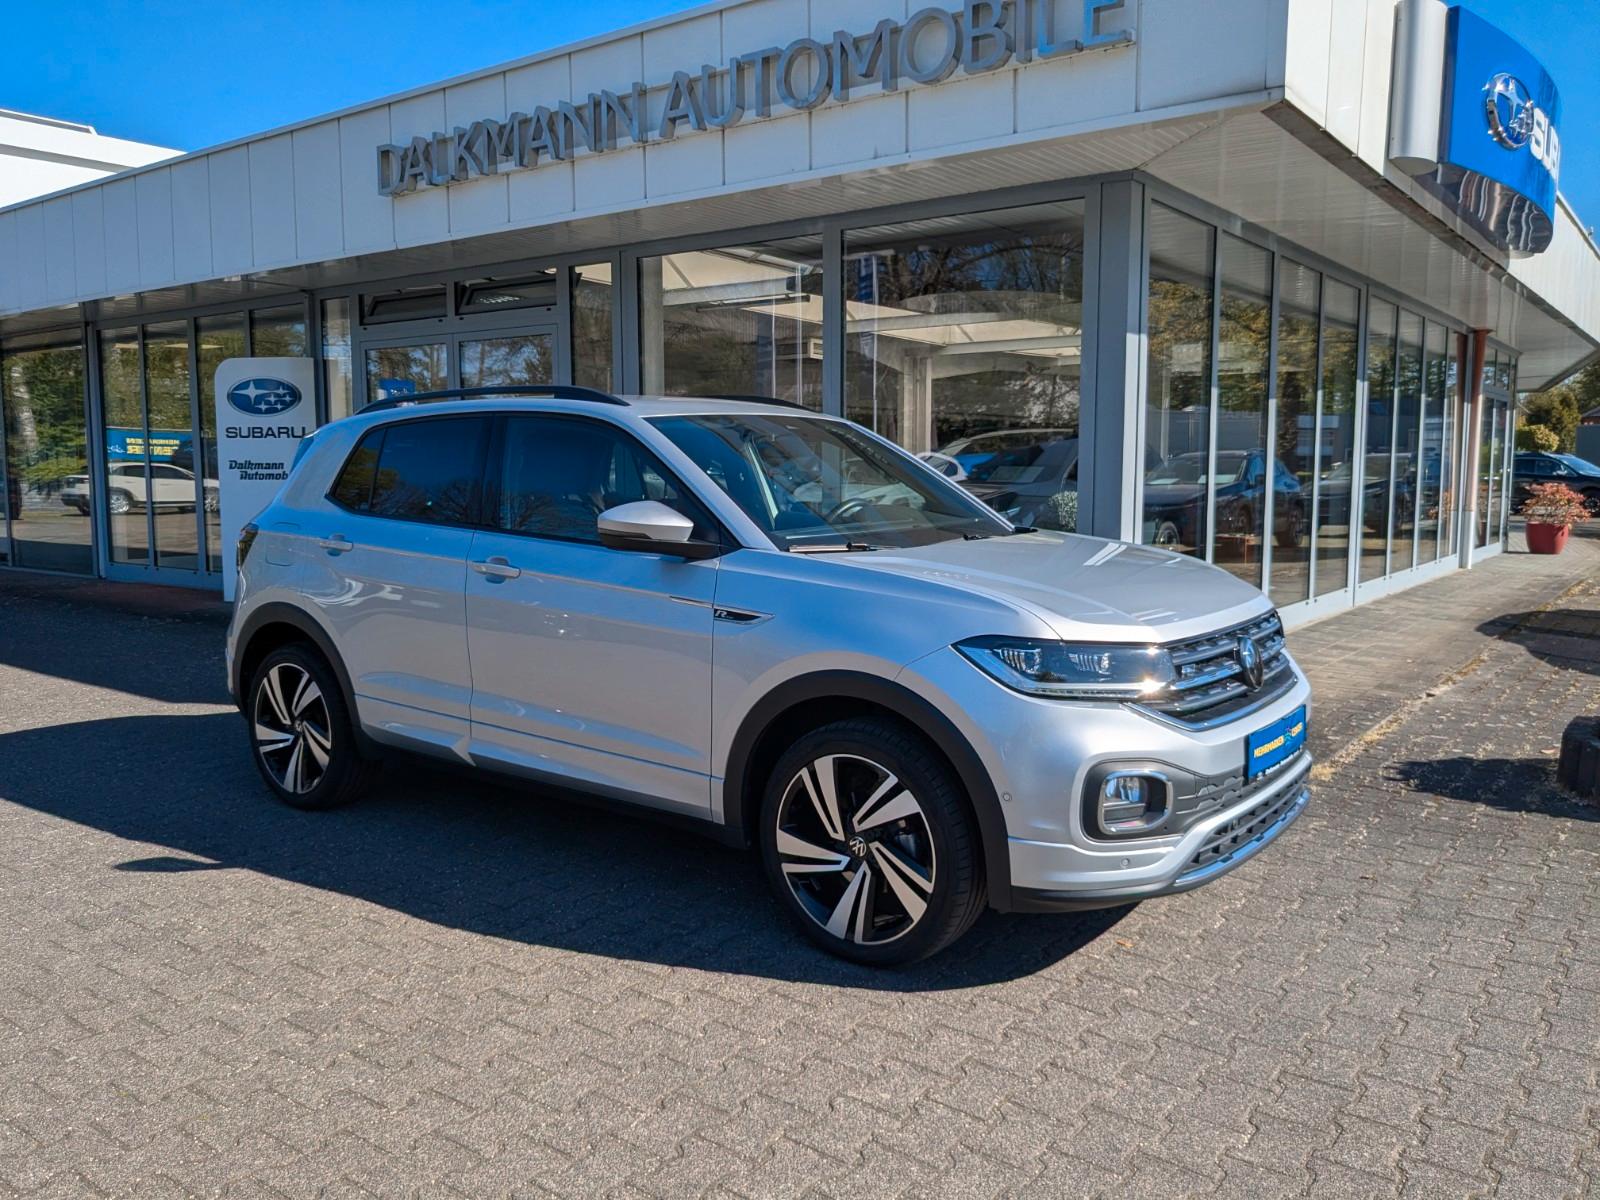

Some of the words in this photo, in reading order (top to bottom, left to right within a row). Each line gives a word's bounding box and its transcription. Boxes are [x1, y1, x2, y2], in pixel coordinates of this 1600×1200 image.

[377, 82, 648, 197] DALKMANN
[659, 0, 1137, 138] AUTOMOBILE
[1530, 107, 1560, 182] SUB
[225, 426, 305, 439] SUBARU
[228, 459, 285, 470] Dalkmann
[239, 470, 289, 480] Automob
